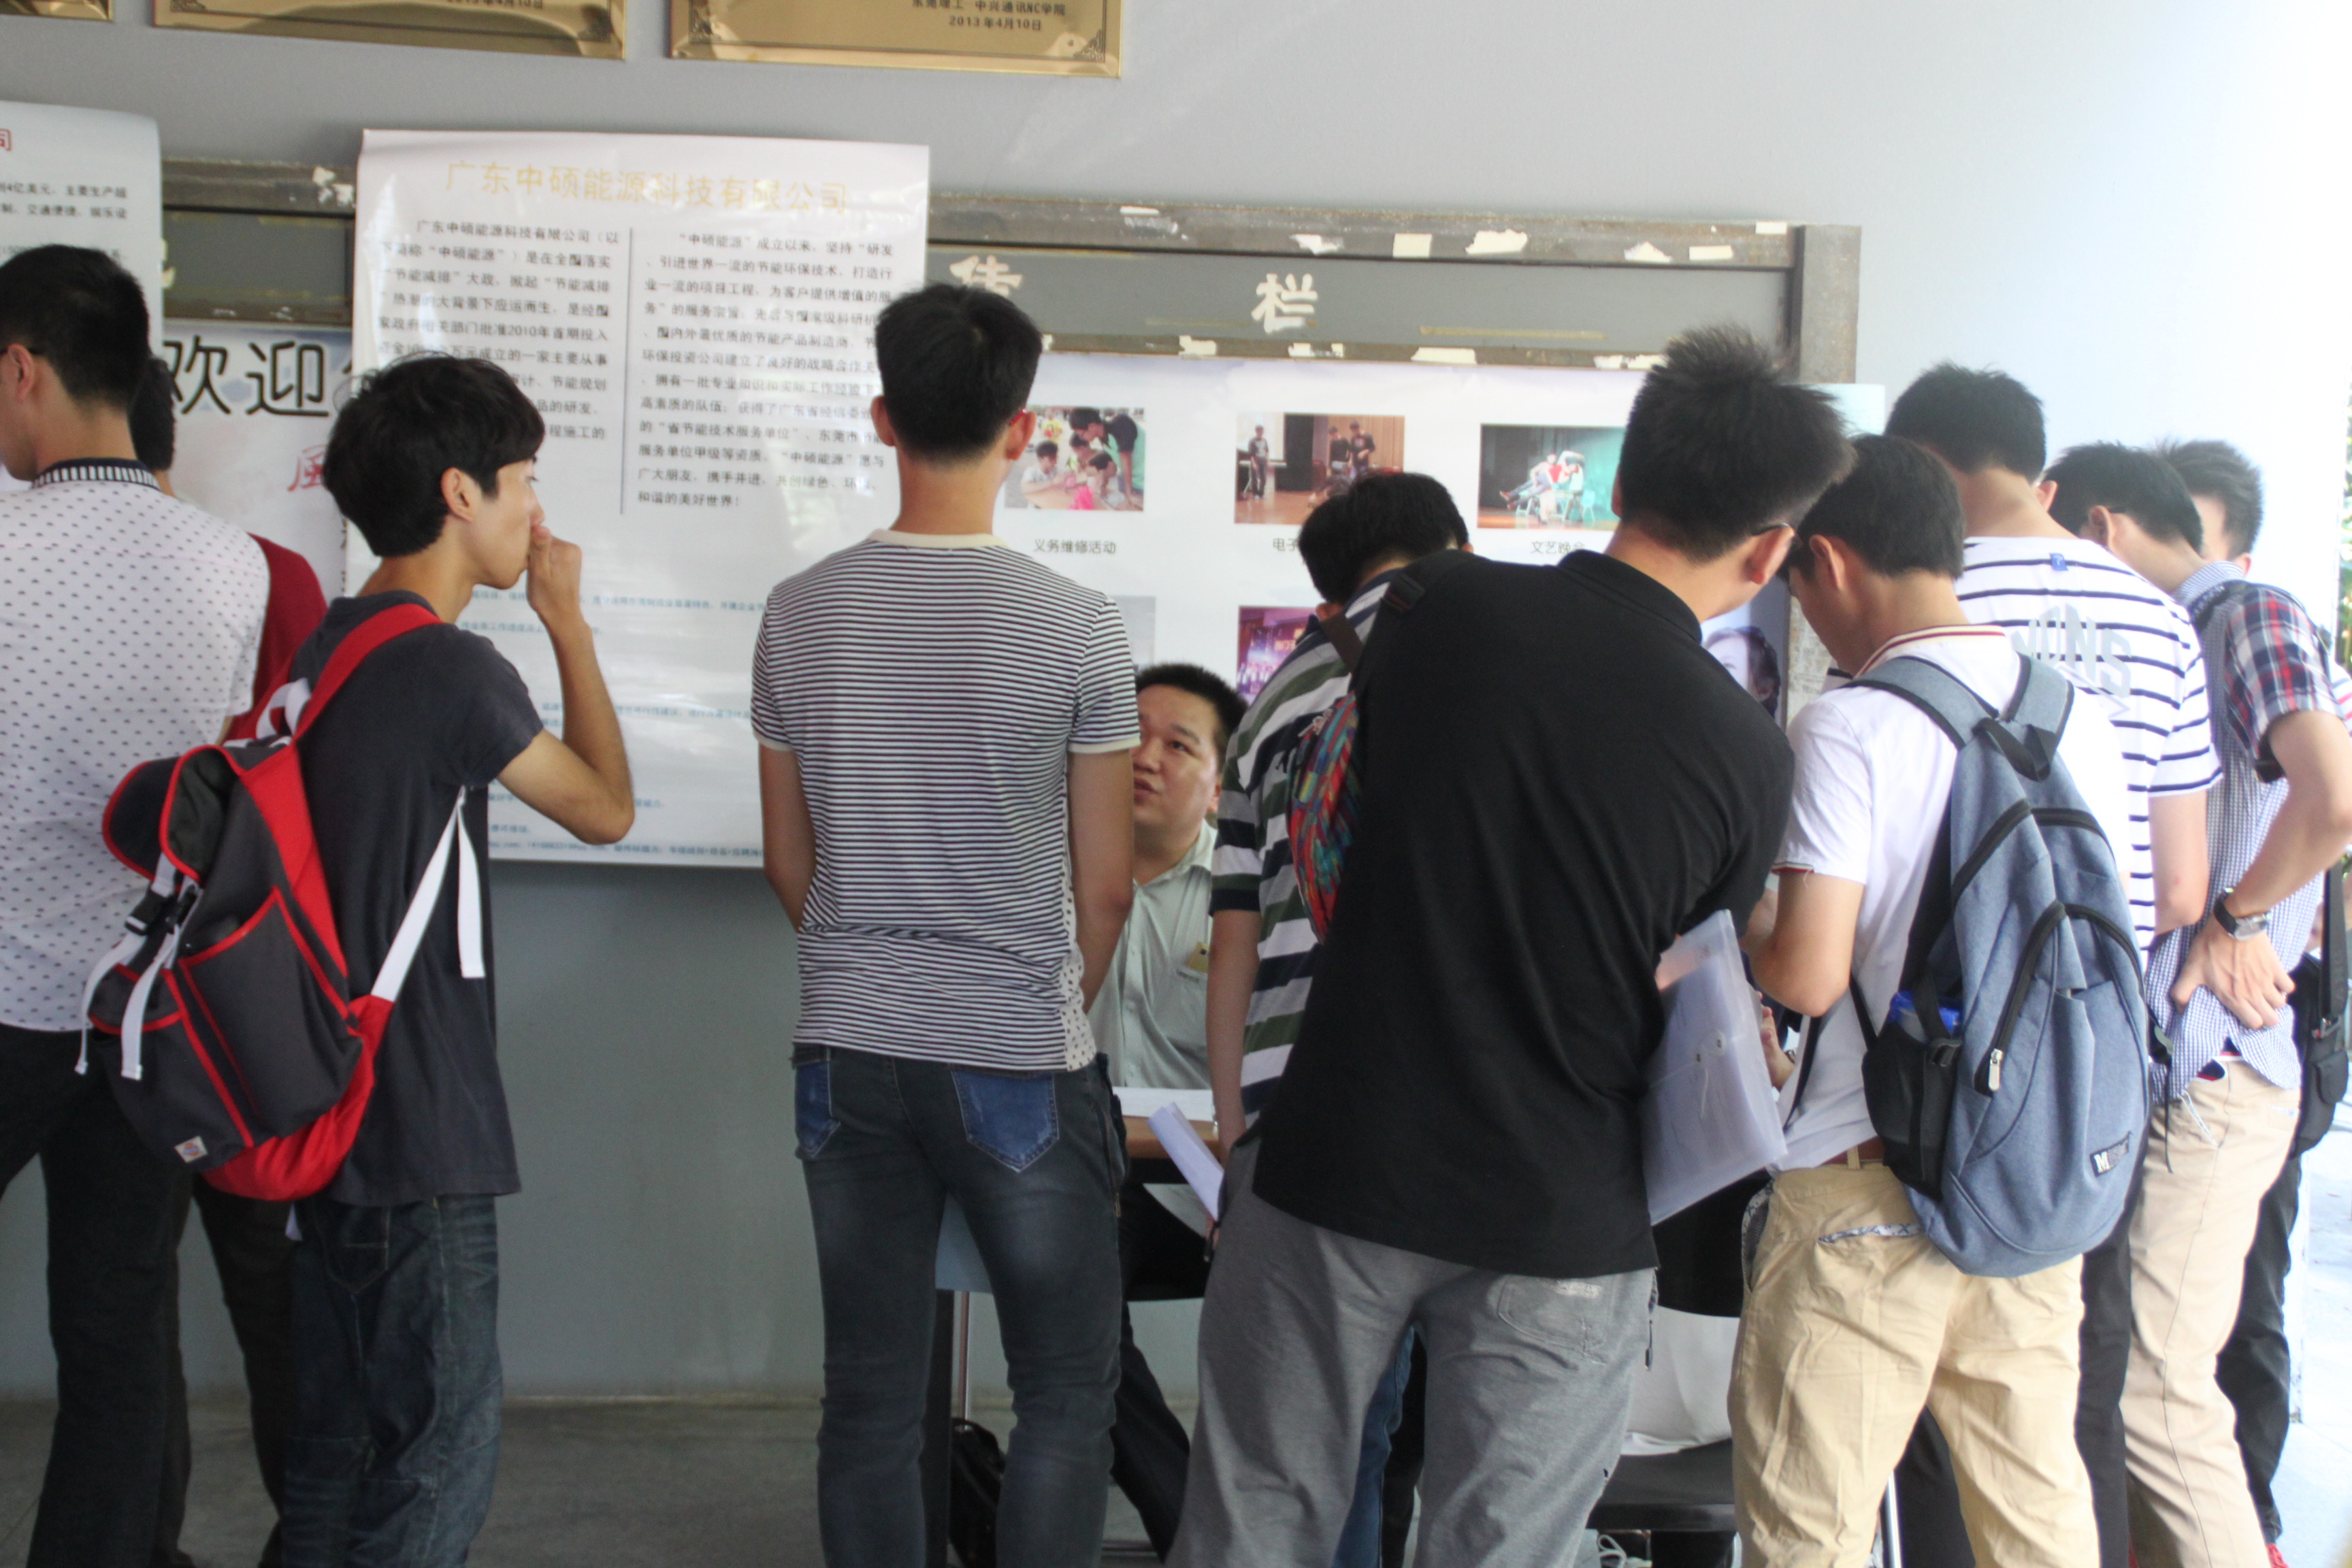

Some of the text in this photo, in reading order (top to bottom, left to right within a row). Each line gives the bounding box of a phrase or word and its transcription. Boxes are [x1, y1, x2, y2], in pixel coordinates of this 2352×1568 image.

[445, 159, 847, 215] 广东中硕能源科技有限公司
[1251, 273, 1318, 333] 栏
[163, 336, 352, 417] 欢迎
[1033, 538, 1117, 555] 义务维修活动
